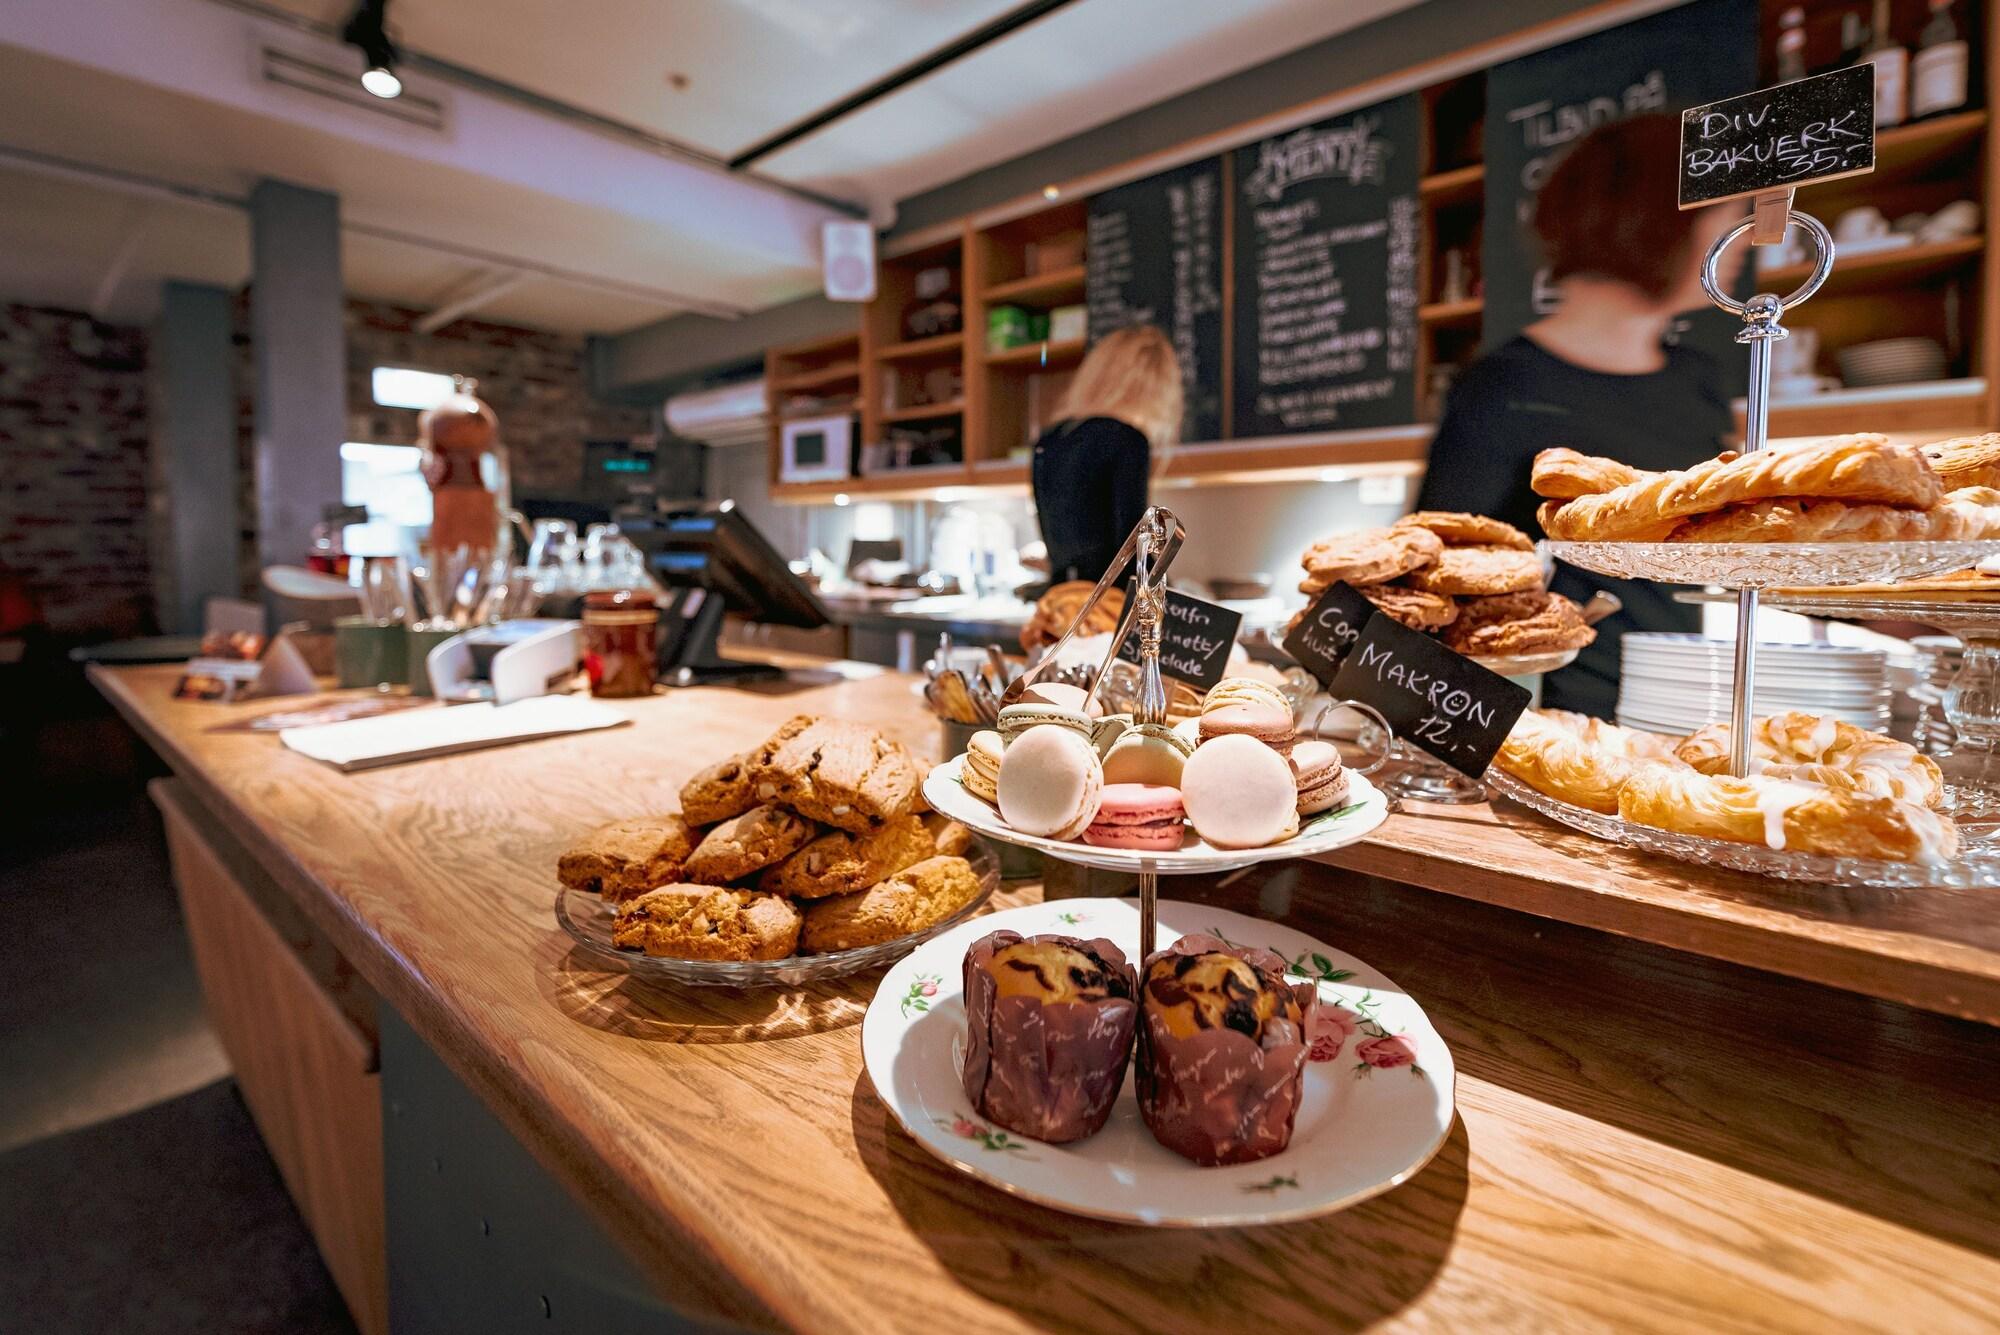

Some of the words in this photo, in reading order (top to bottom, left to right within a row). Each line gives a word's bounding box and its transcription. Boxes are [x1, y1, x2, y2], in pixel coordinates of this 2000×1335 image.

[1700, 104, 1777, 139] DIV.
[1318, 607, 1360, 642] Coo
[1358, 642, 1496, 729] MAKRON
